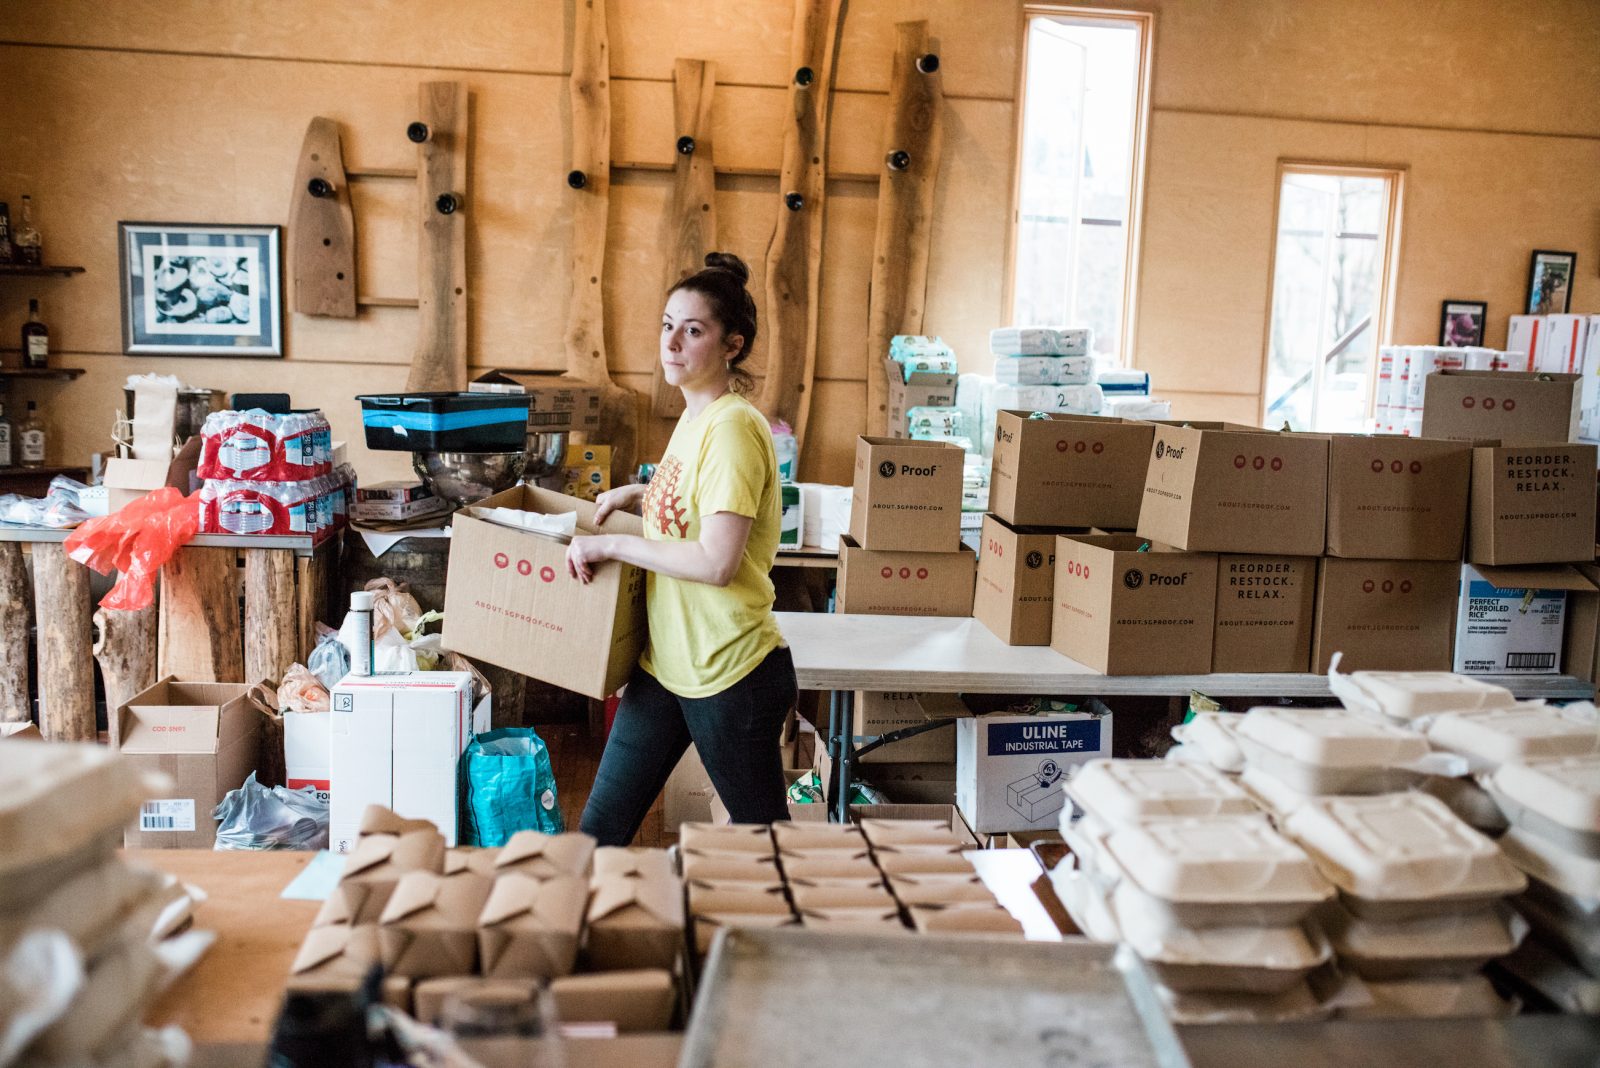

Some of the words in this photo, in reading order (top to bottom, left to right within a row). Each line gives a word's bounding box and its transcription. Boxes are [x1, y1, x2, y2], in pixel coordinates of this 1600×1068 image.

[1062, 364, 1073, 376] 2
[1058, 393, 1068, 407] 2
[1166, 446, 1184, 459] Proof
[1507, 455, 1576, 465] REORDER.
[902, 465, 936, 476] Proof
[1508, 468, 1574, 478] RESTOCK.
[1516, 482, 1566, 492] RELAX.
[872, 503, 943, 511] ABOUT.SGPROOF.COM
[1230, 564, 1295, 573] REORDER.
[1149, 572, 1188, 586] Proof
[1230, 577, 1294, 586] RESTOCK.
[1238, 590, 1285, 599] RELAX.
[475, 600, 564, 633] ABOUT.SGPROOF.COM
[1022, 726, 1067, 739] ULINE
[1005, 741, 1058, 752] INDUSTRIAL
[1062, 740, 1083, 749] TAPE
